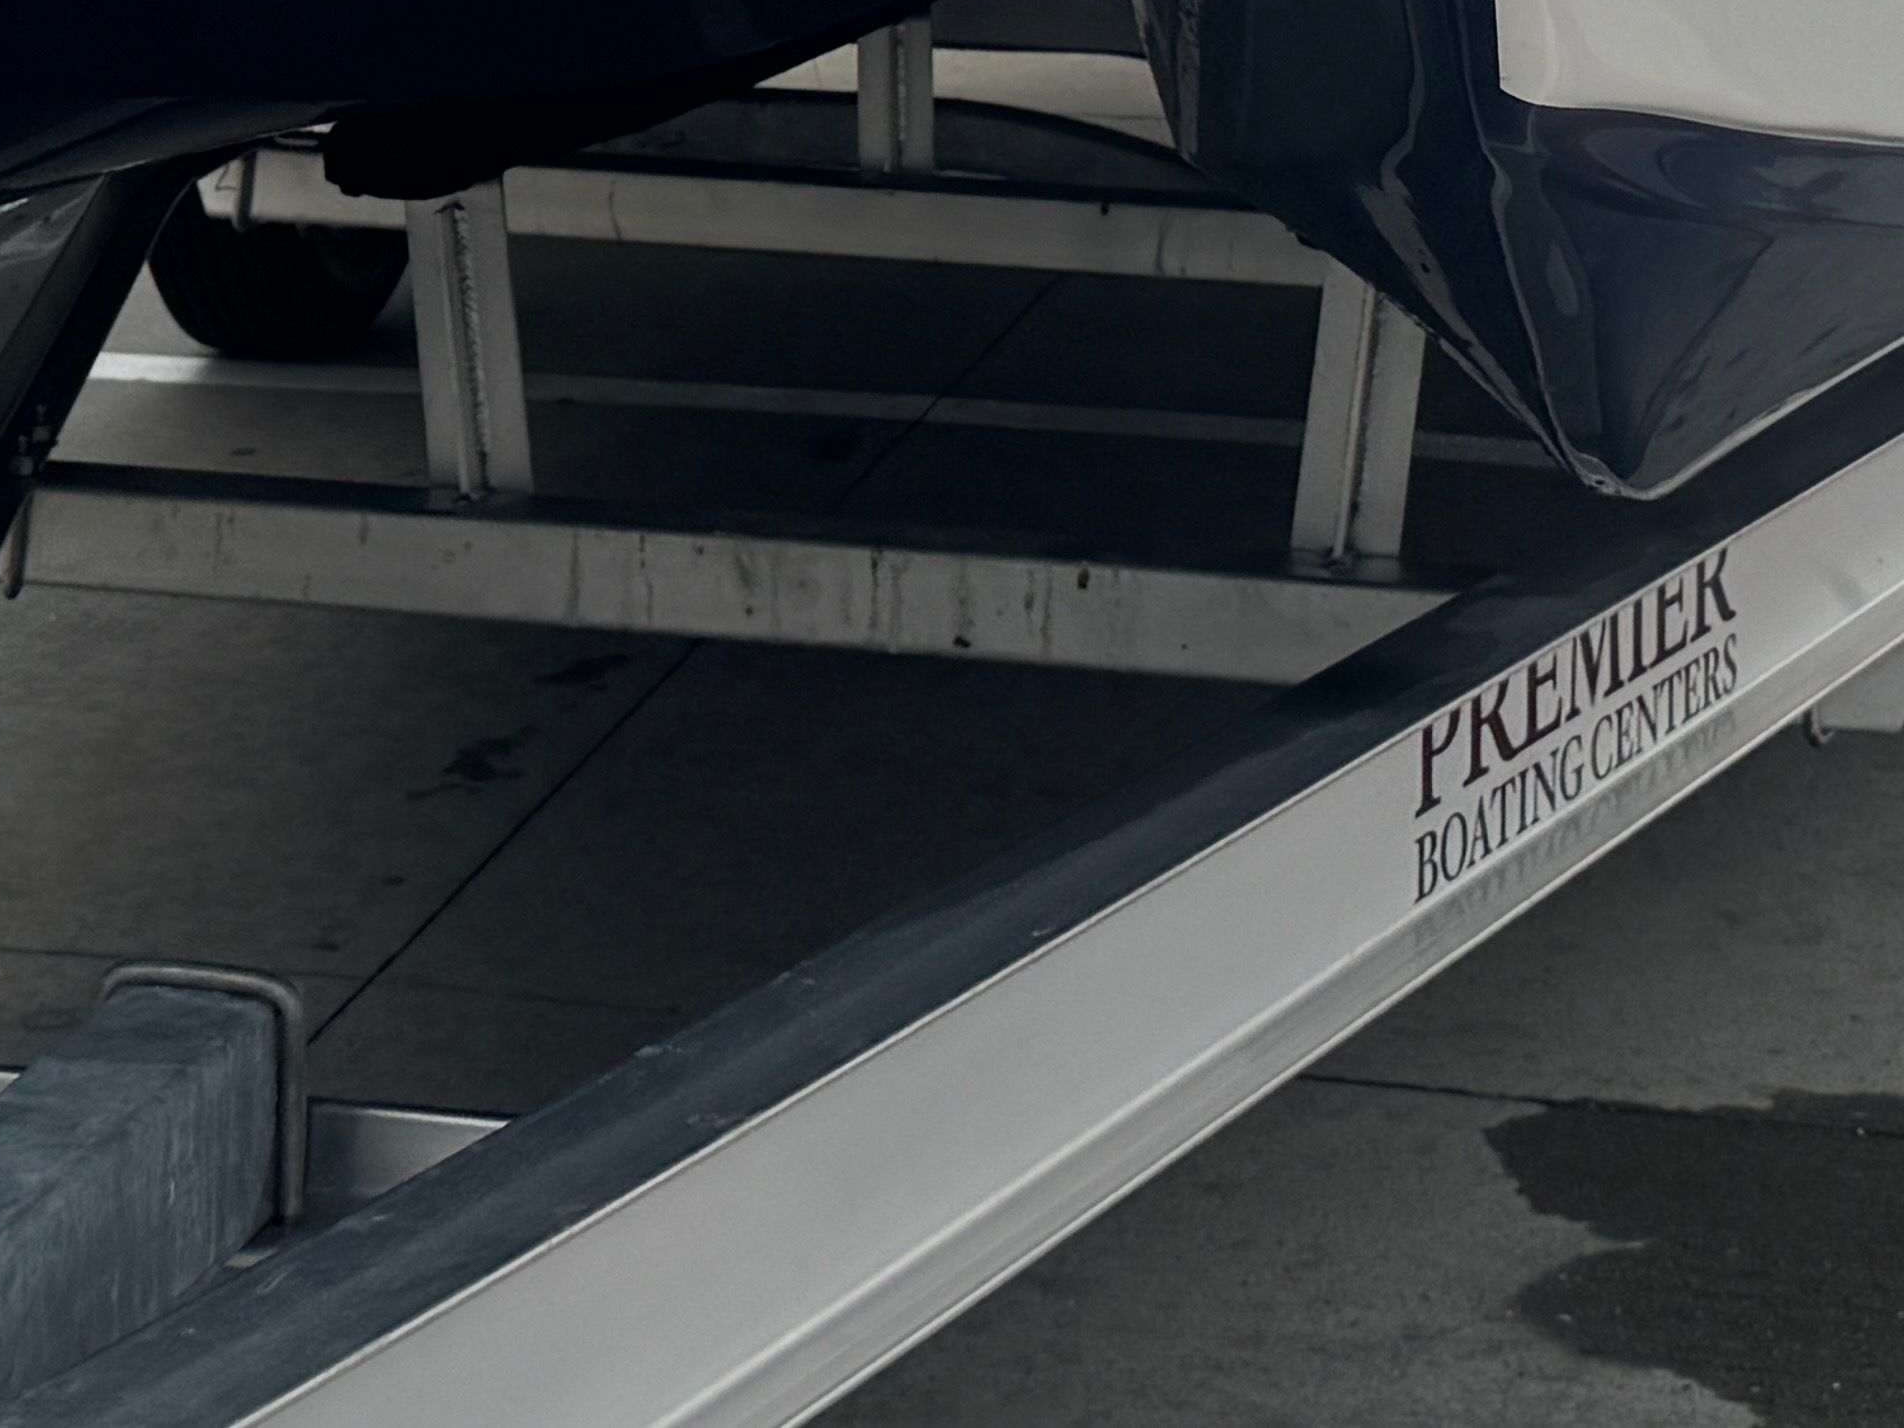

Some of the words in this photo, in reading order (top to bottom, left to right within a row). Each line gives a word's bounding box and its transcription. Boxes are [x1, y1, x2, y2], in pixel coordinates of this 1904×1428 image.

[1414, 546, 1737, 819] PREMIER
[1414, 734, 1584, 904] BOATING
[1591, 632, 1739, 781] CENTERS
